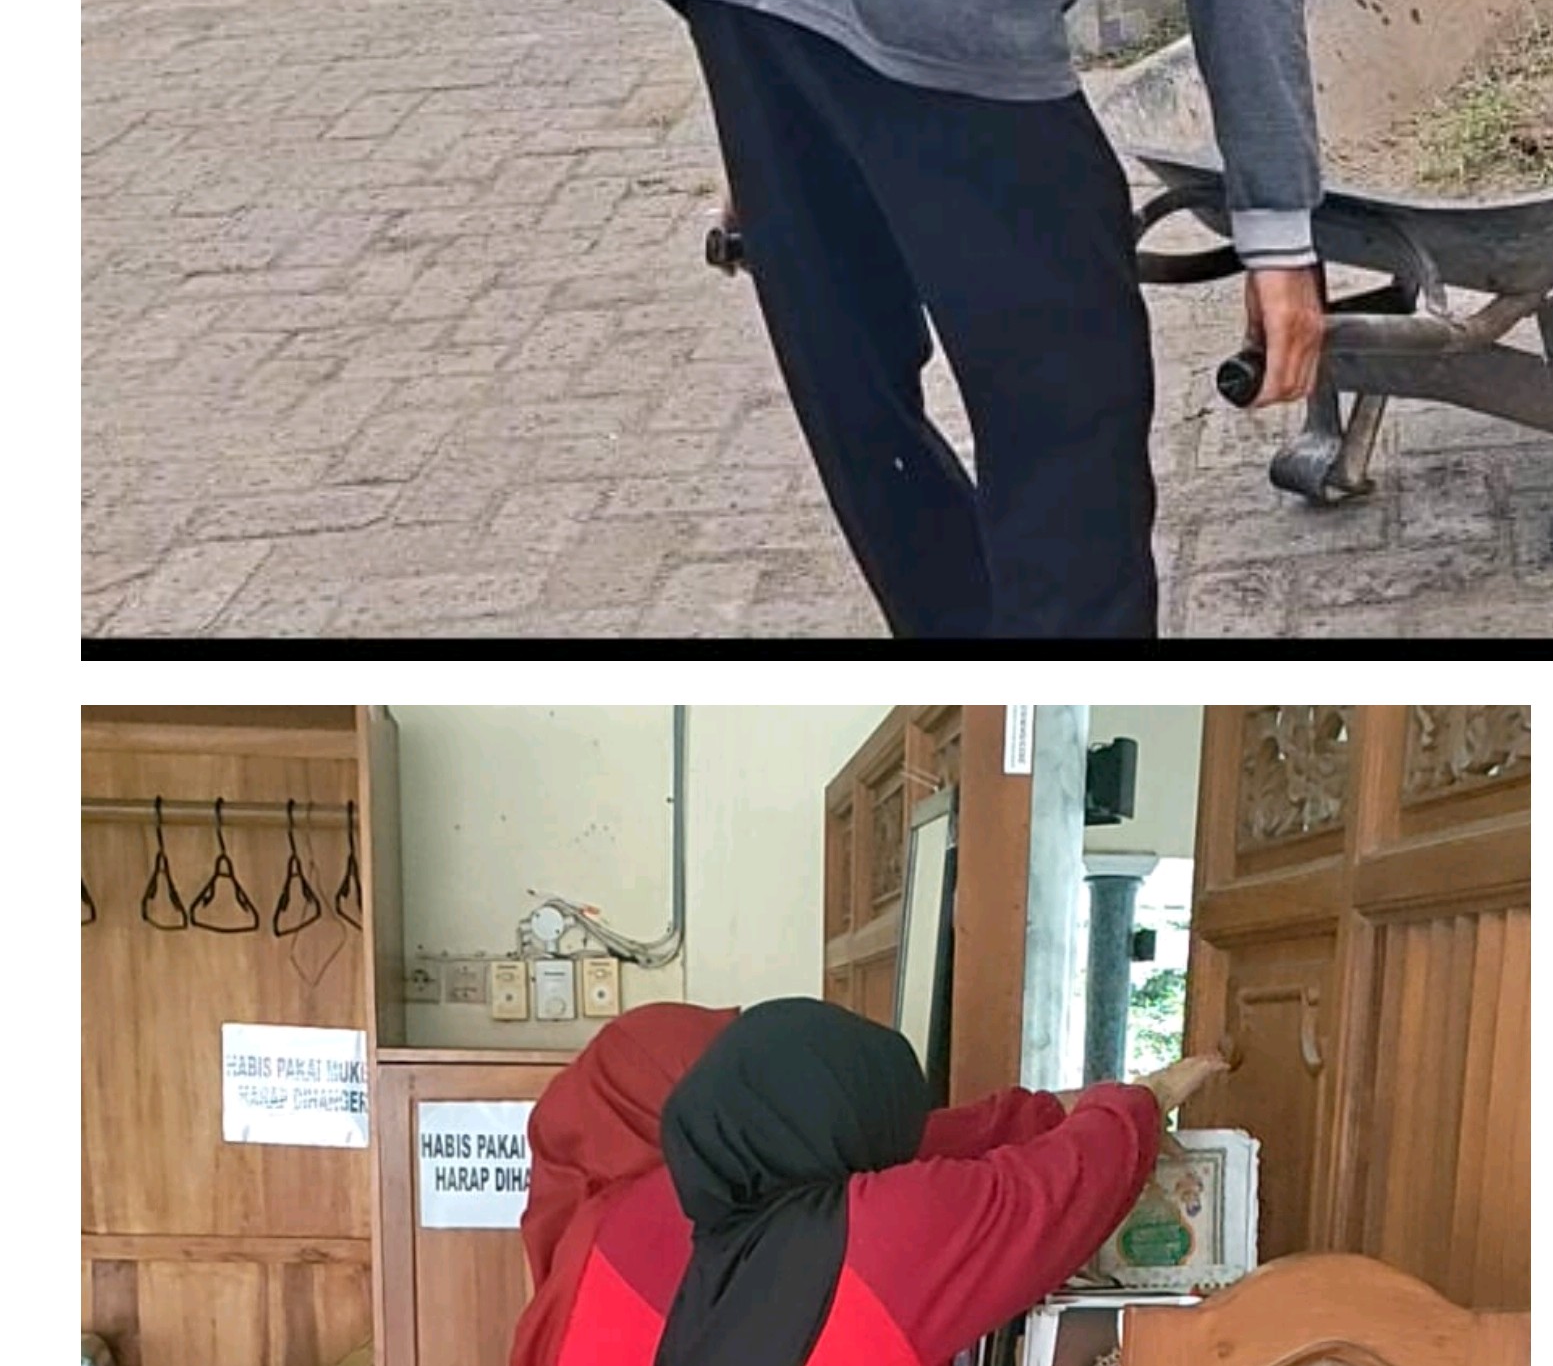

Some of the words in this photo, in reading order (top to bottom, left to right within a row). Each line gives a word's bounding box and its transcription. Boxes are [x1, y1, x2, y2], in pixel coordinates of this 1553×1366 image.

[226, 1054, 272, 1078] HABIS
[277, 1057, 321, 1082] PAKAI
[421, 1133, 472, 1159] HABIS
[477, 1133, 526, 1159] PAKAI
[435, 1166, 490, 1191] HARAP
